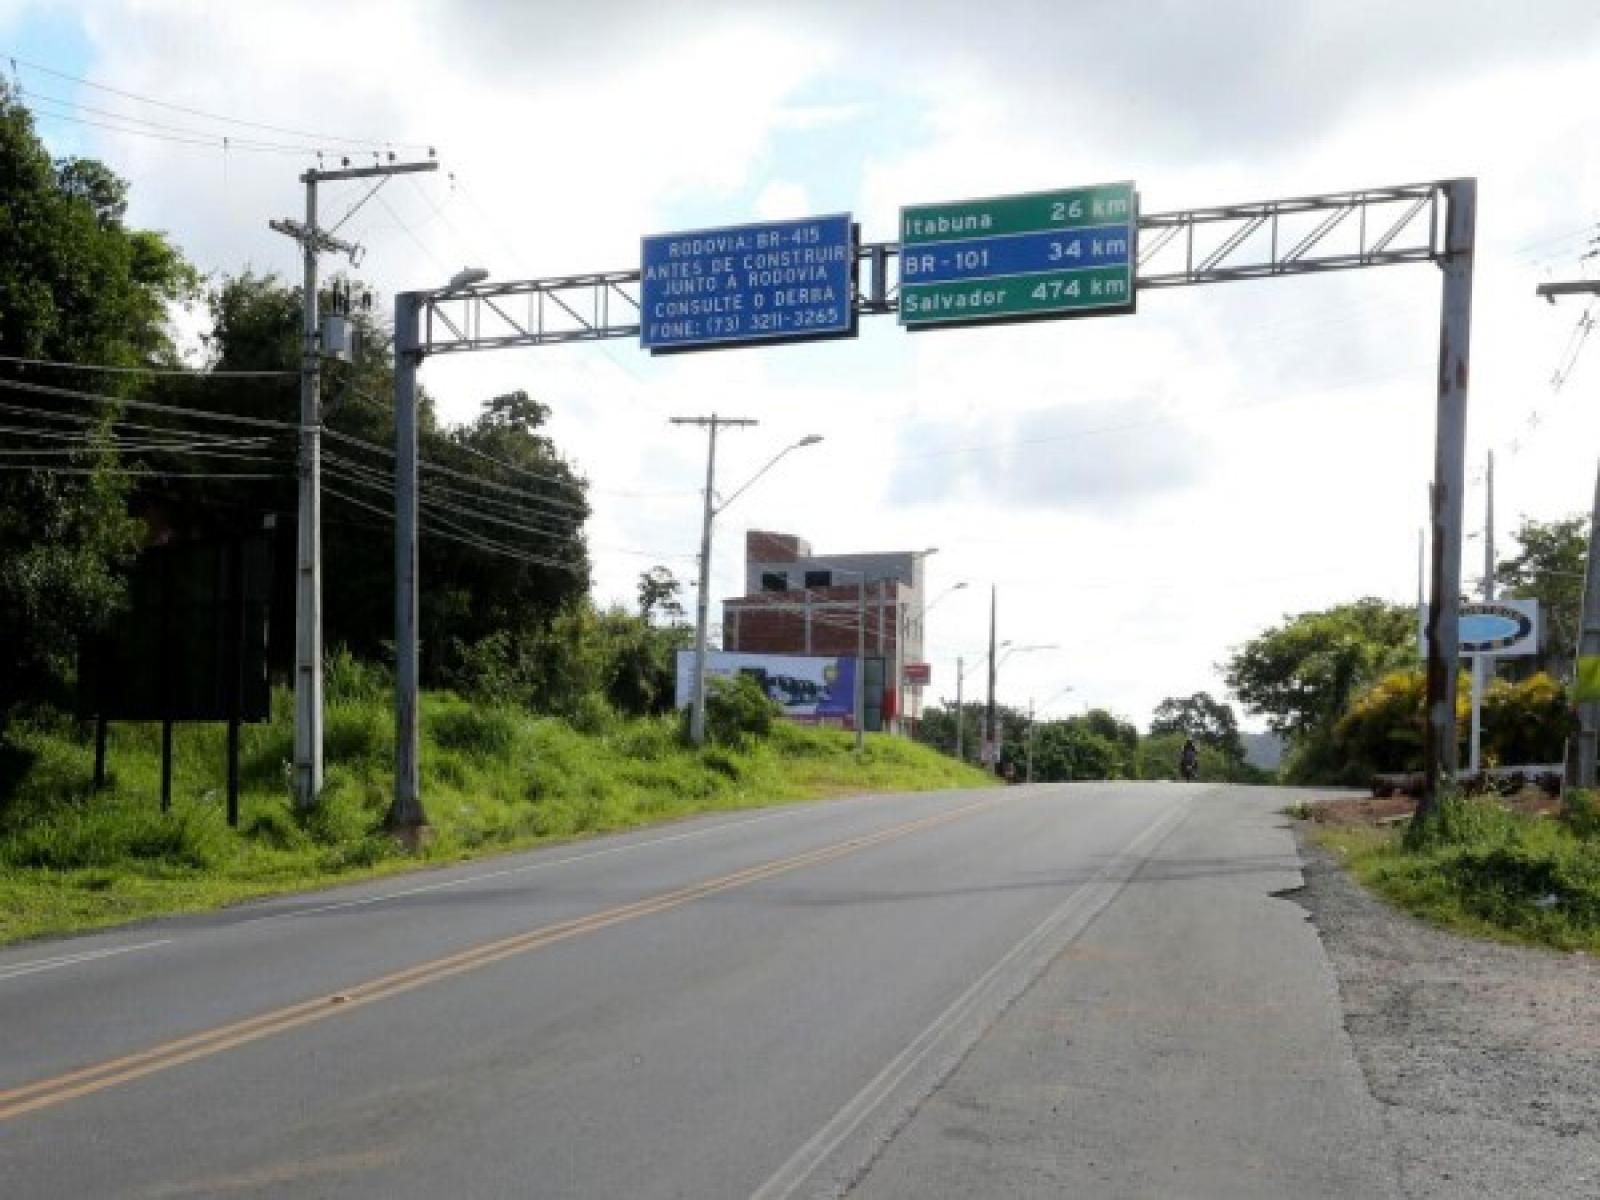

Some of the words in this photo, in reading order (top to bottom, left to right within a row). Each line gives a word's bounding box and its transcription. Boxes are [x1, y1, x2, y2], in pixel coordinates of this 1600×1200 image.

[1050, 200, 1082, 221] 26
[1093, 198, 1127, 216] km
[669, 237, 745, 257] RODOVIA
[757, 226, 820, 249] BR-415
[1048, 240, 1081, 261] 34
[1092, 239, 1126, 255] km
[646, 261, 702, 281] ANTES
[711, 257, 738, 273] DE
[744, 246, 846, 269] CONSTRUIR
[663, 276, 716, 296] JUNTO
[749, 266, 828, 287] RODOVIA
[906, 289, 1007, 312] Salvador
[1032, 280, 1081, 300] 474
[1090, 278, 1125, 295] km
[655, 294, 744, 317] CONSULTE
